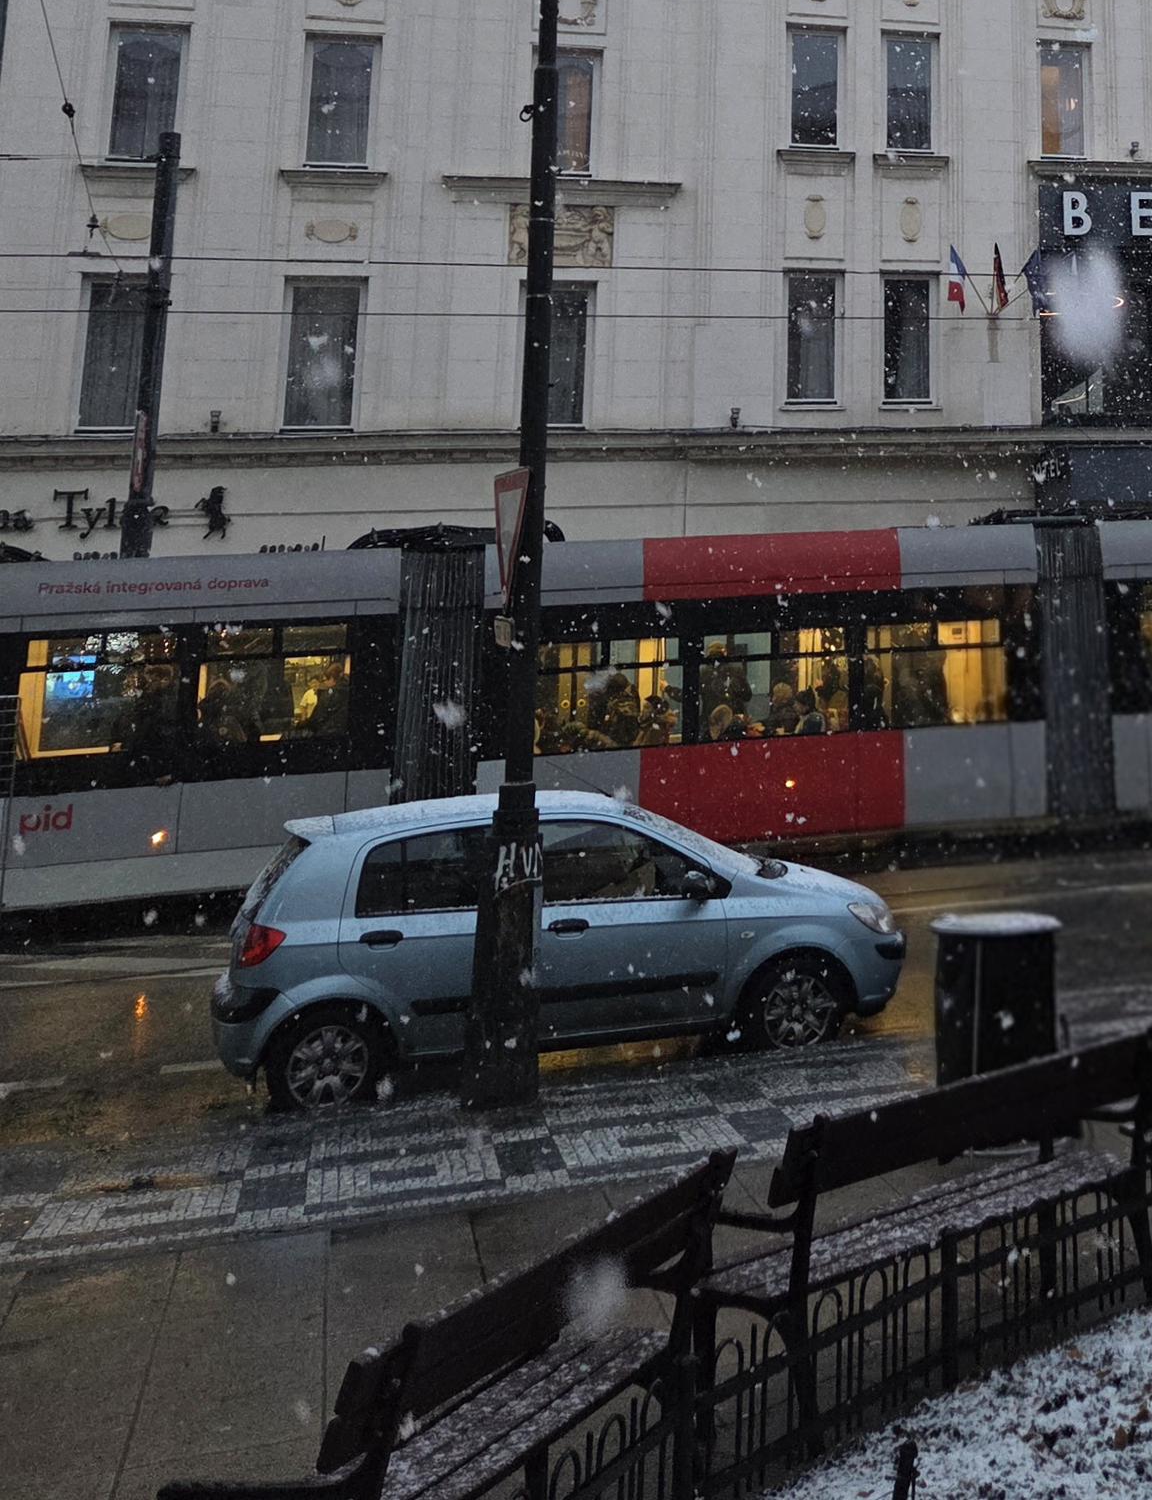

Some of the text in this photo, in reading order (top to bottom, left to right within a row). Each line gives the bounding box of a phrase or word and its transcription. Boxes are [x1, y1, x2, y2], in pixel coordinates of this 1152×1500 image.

[38, 577, 269, 595] Pražská integrovaná doprava
[19, 804, 74, 836] pid
